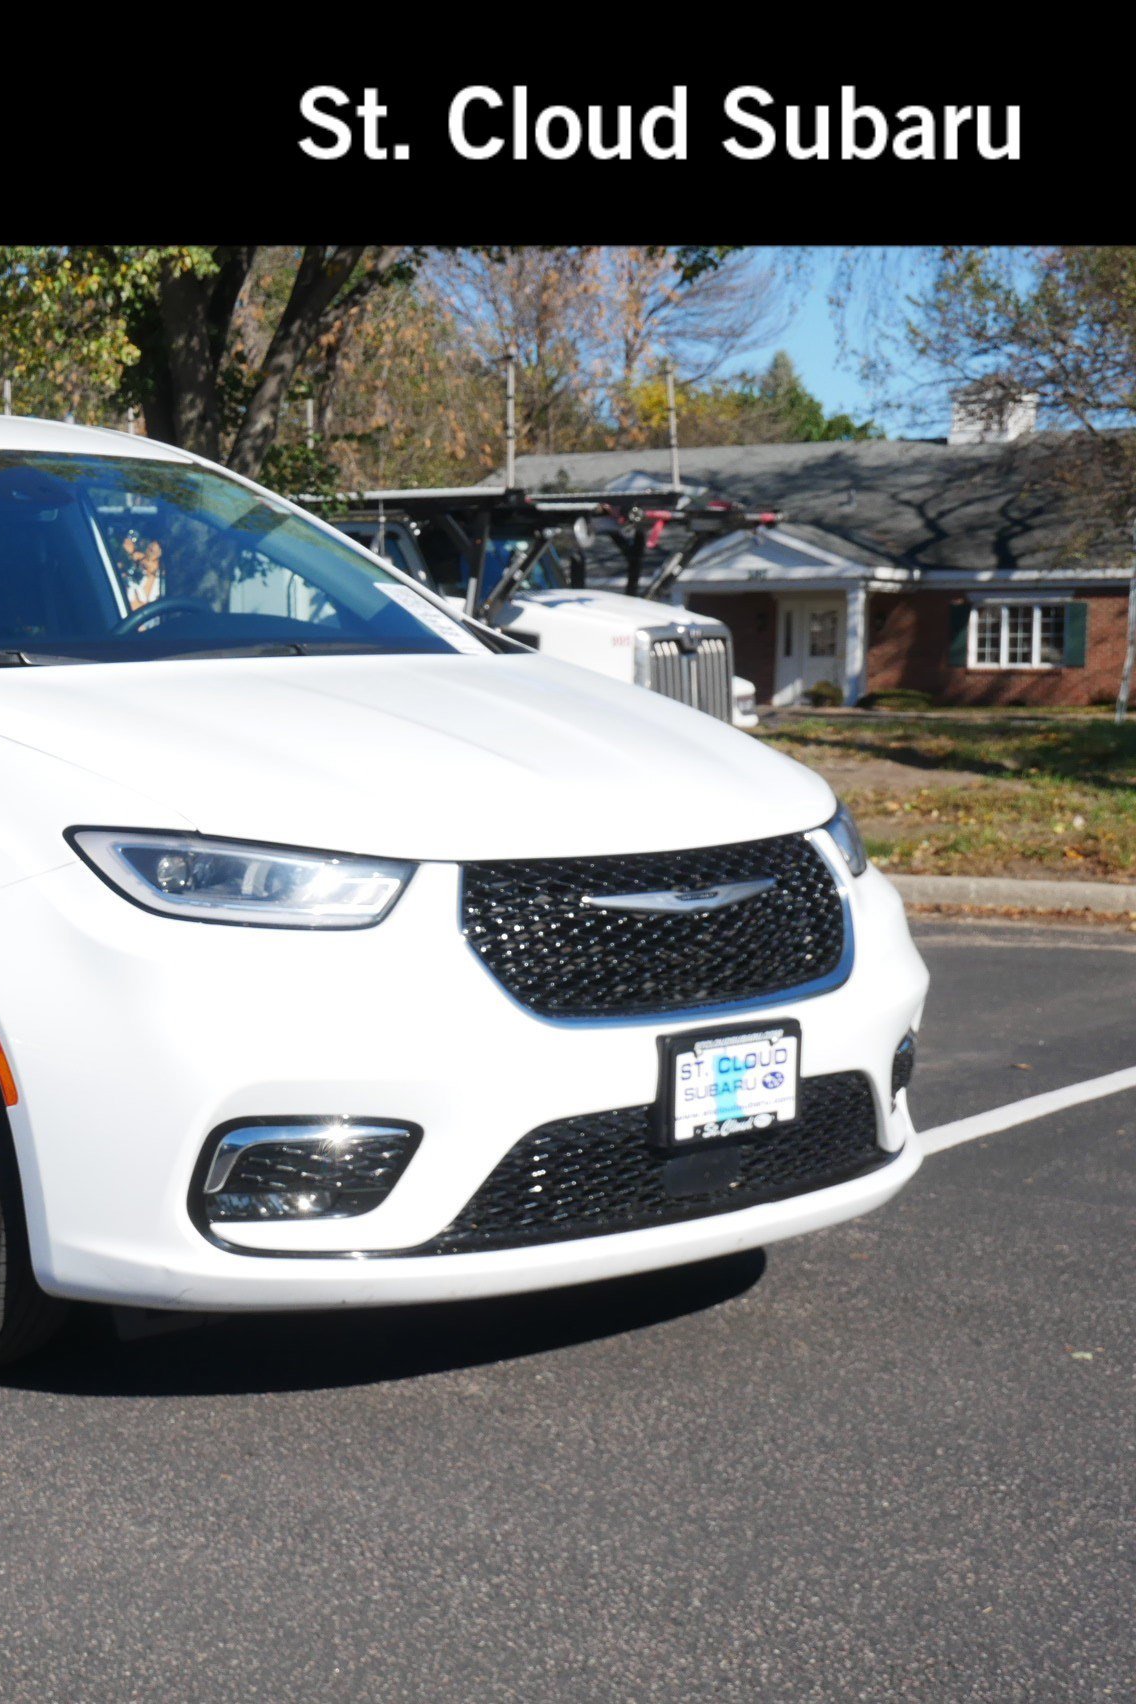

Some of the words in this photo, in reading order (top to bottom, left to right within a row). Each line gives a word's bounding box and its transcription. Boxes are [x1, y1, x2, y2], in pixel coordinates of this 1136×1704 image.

[680, 1060, 709, 1081] ST.
[718, 1048, 788, 1074] CLOUD
[683, 1077, 757, 1102] SUBARU
